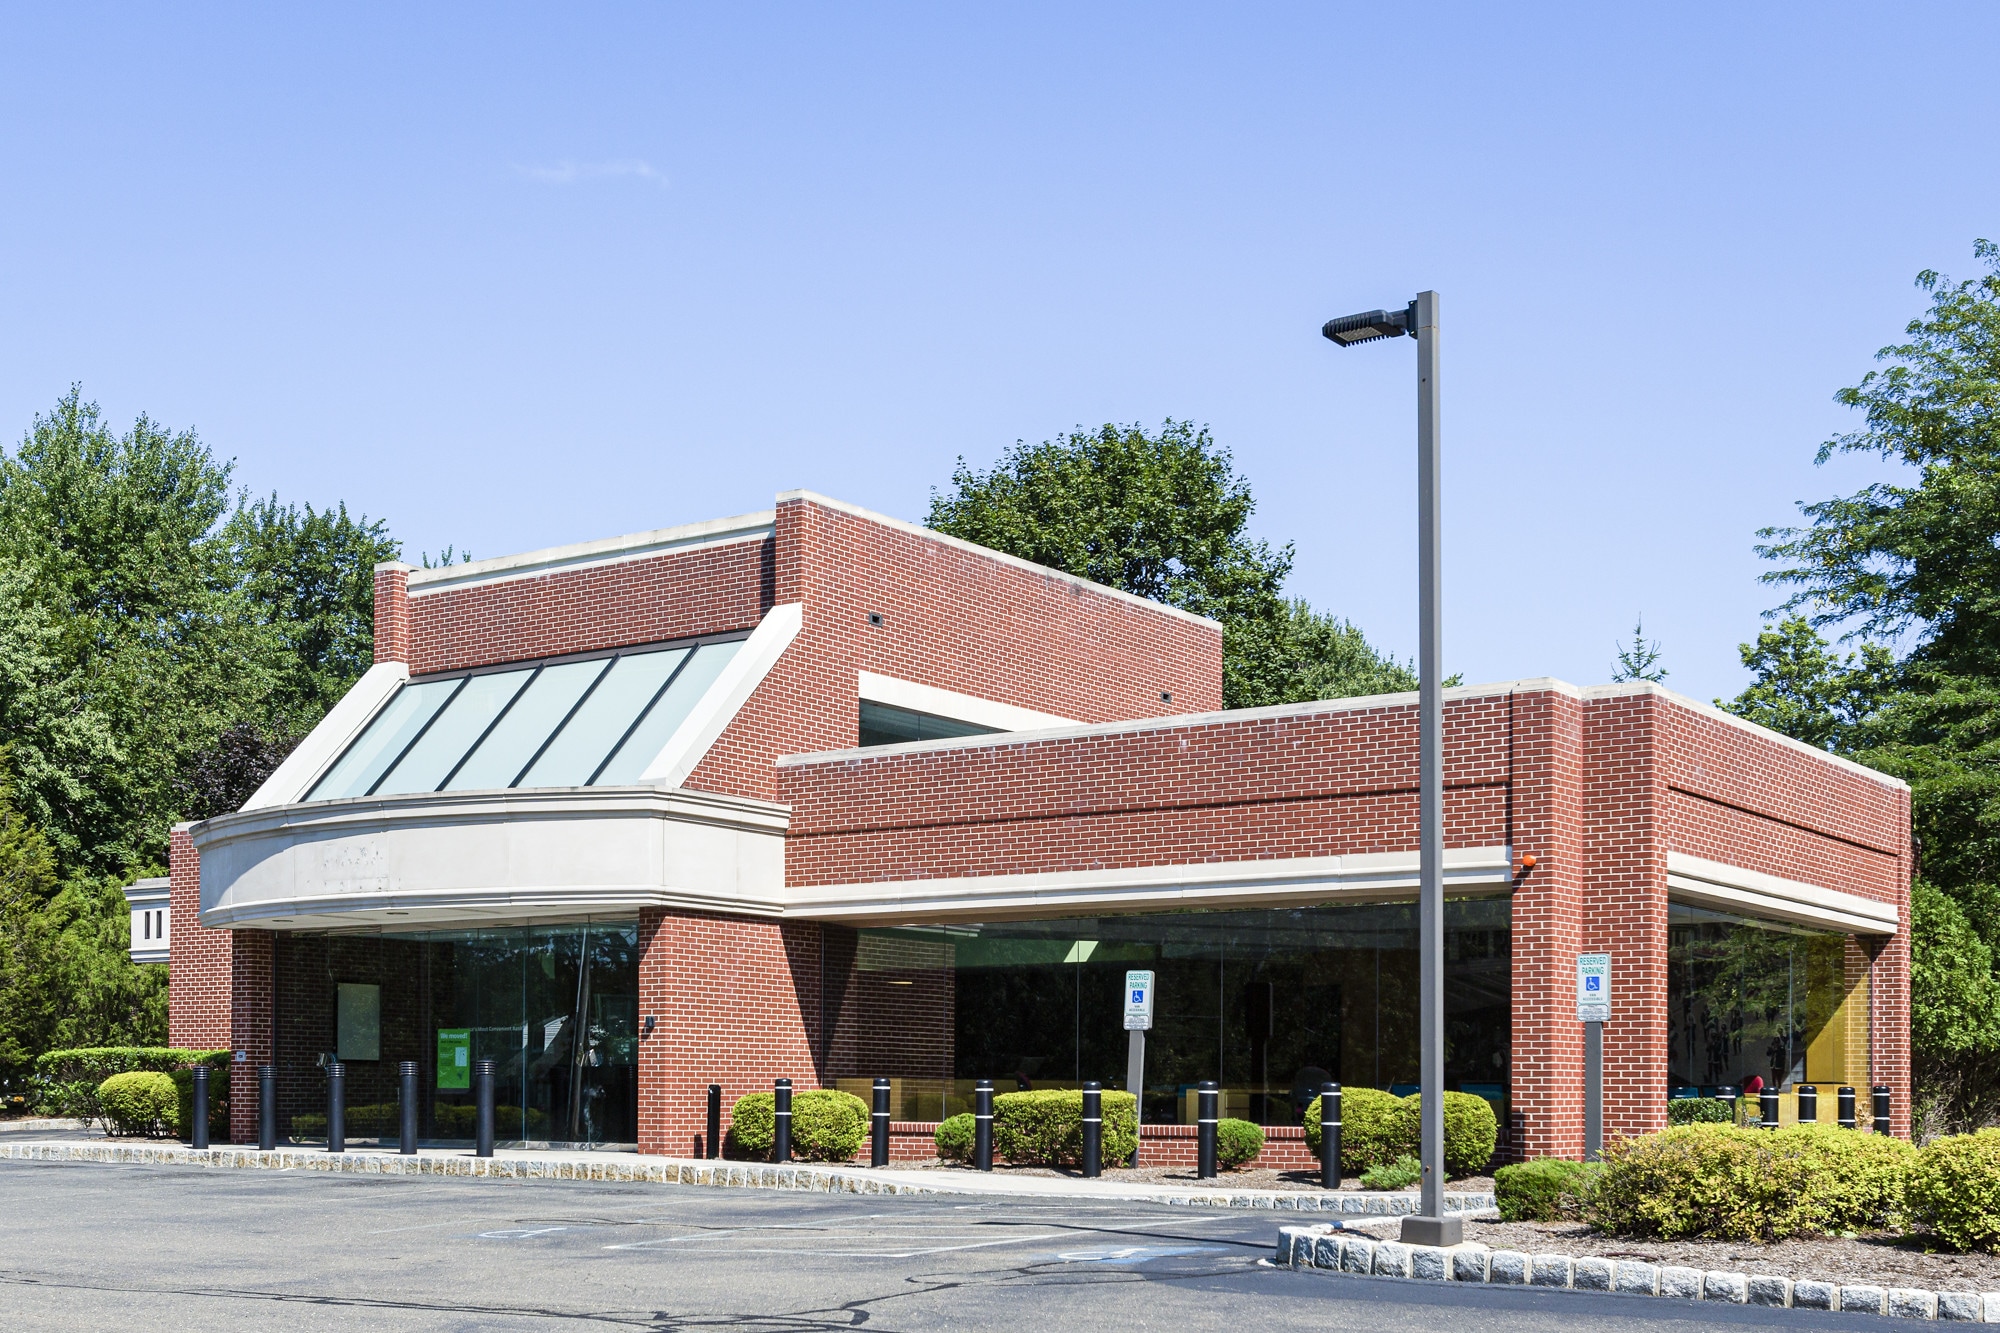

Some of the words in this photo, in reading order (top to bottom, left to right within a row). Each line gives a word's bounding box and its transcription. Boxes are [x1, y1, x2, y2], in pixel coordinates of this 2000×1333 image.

[1579, 956, 1606, 966] RESERVED
[1581, 966, 1604, 975] PARKING
[1128, 973, 1150, 981] RESERVED
[1129, 981, 1148, 989] PARKING
